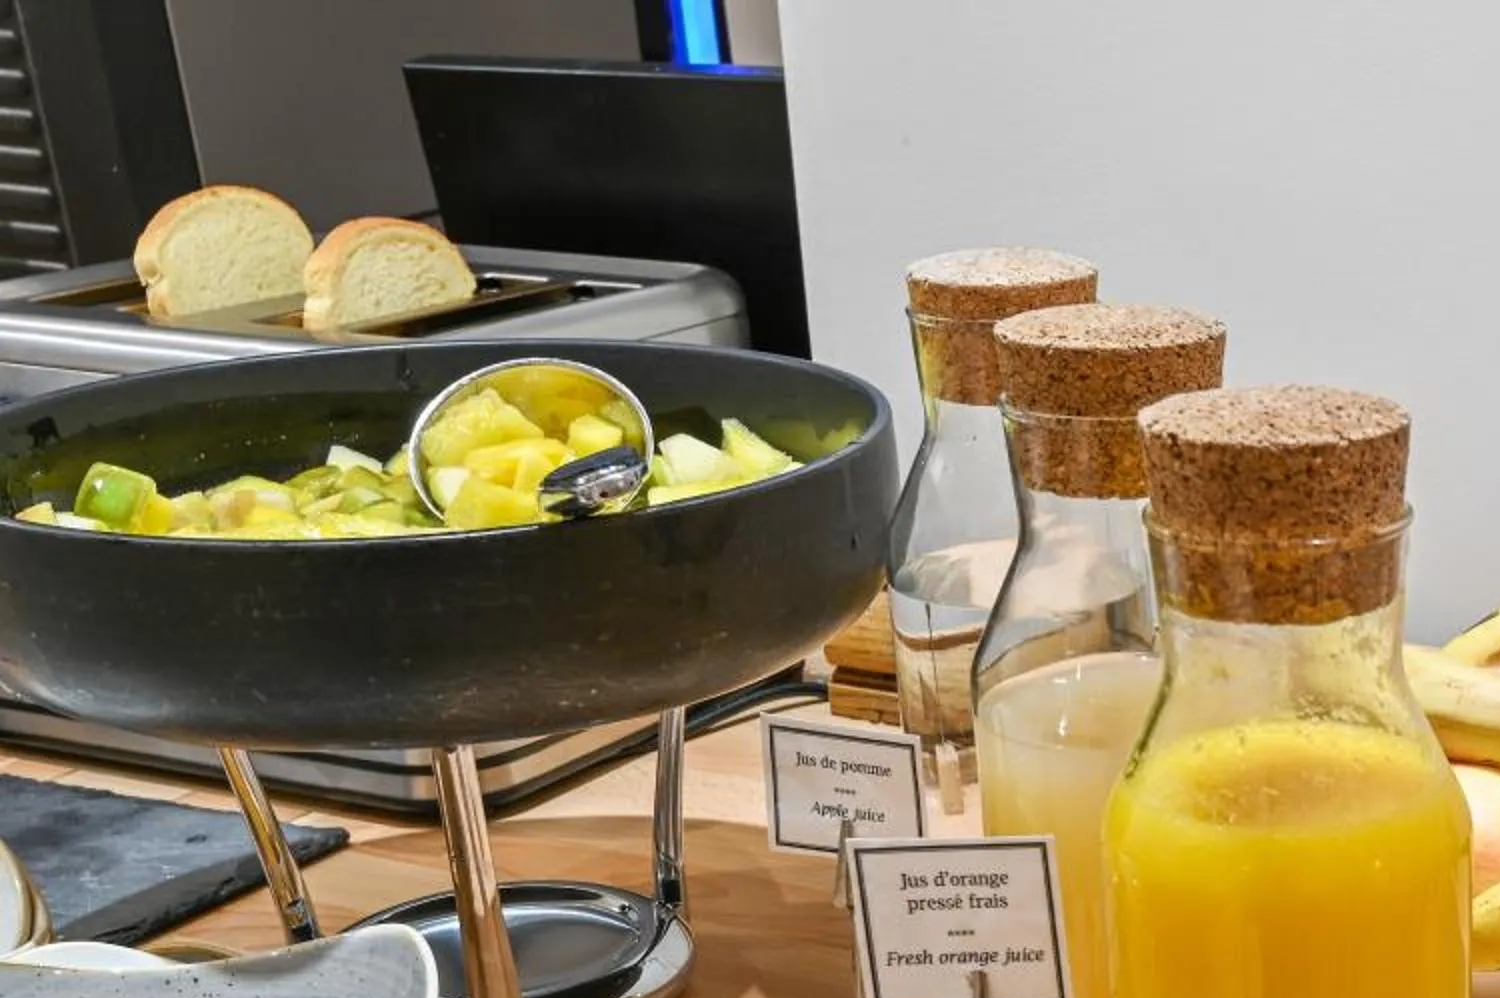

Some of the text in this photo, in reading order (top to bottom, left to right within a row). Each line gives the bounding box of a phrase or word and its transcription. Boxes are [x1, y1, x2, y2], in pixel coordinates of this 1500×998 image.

[796, 752, 893, 778] Jus de pomme
[811, 800, 886, 823] Apple juice
[900, 871, 1009, 891] Jus d'orange
[907, 893, 1009, 915] pressé frais
[886, 947, 1046, 967] Fresh orange juice
